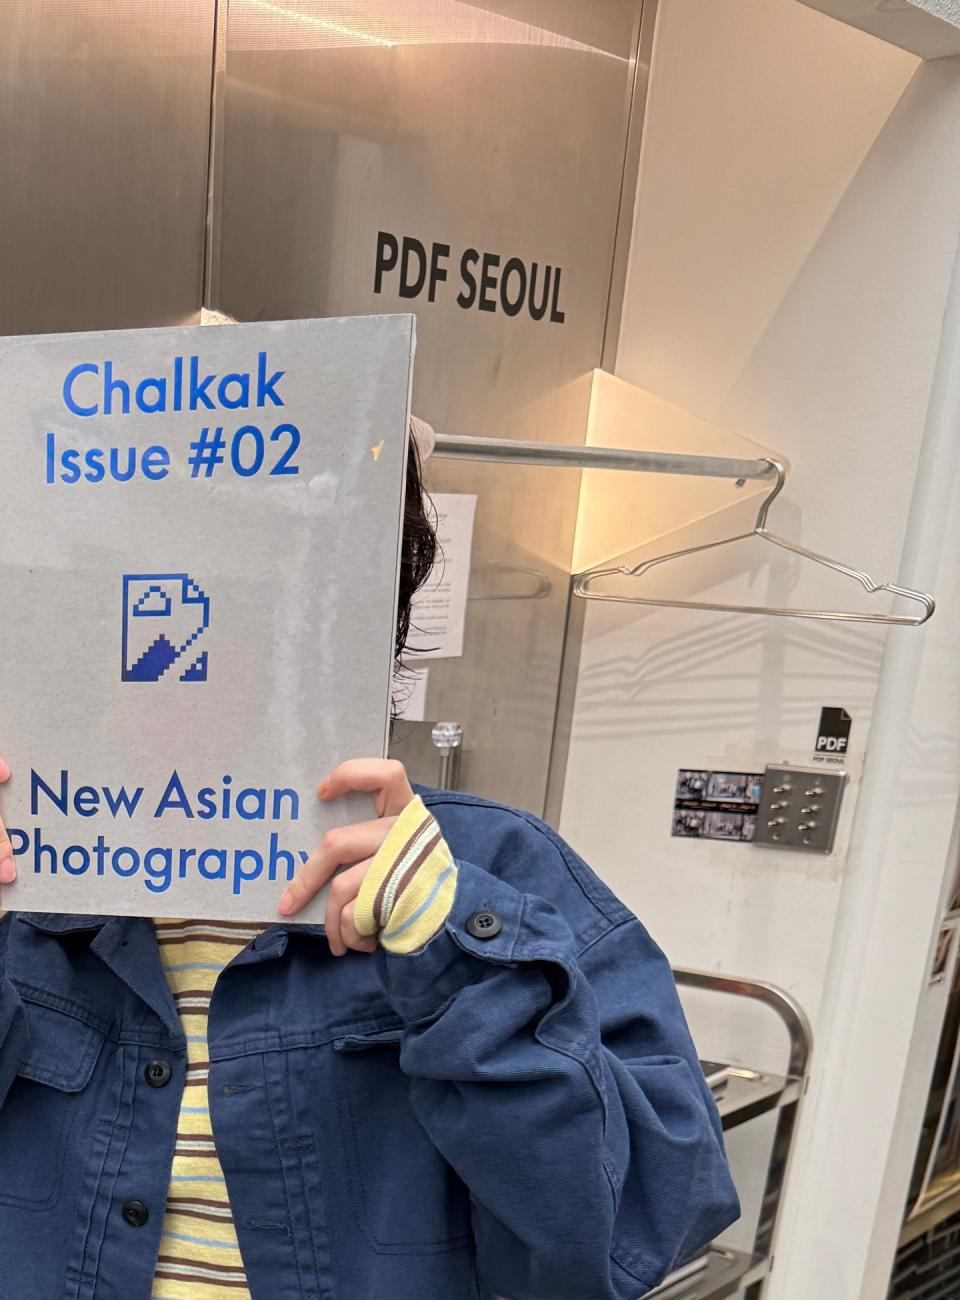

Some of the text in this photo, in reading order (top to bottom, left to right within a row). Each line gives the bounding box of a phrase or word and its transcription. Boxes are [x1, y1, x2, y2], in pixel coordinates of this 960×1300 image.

[373, 231, 566, 324] PDF SEOUL
[62, 352, 287, 417] Chalkak
[46, 423, 301, 484] Issue #02
[817, 736, 847, 751] PDF
[30, 767, 300, 821] New Asian
[5, 827, 309, 895] Photograph
